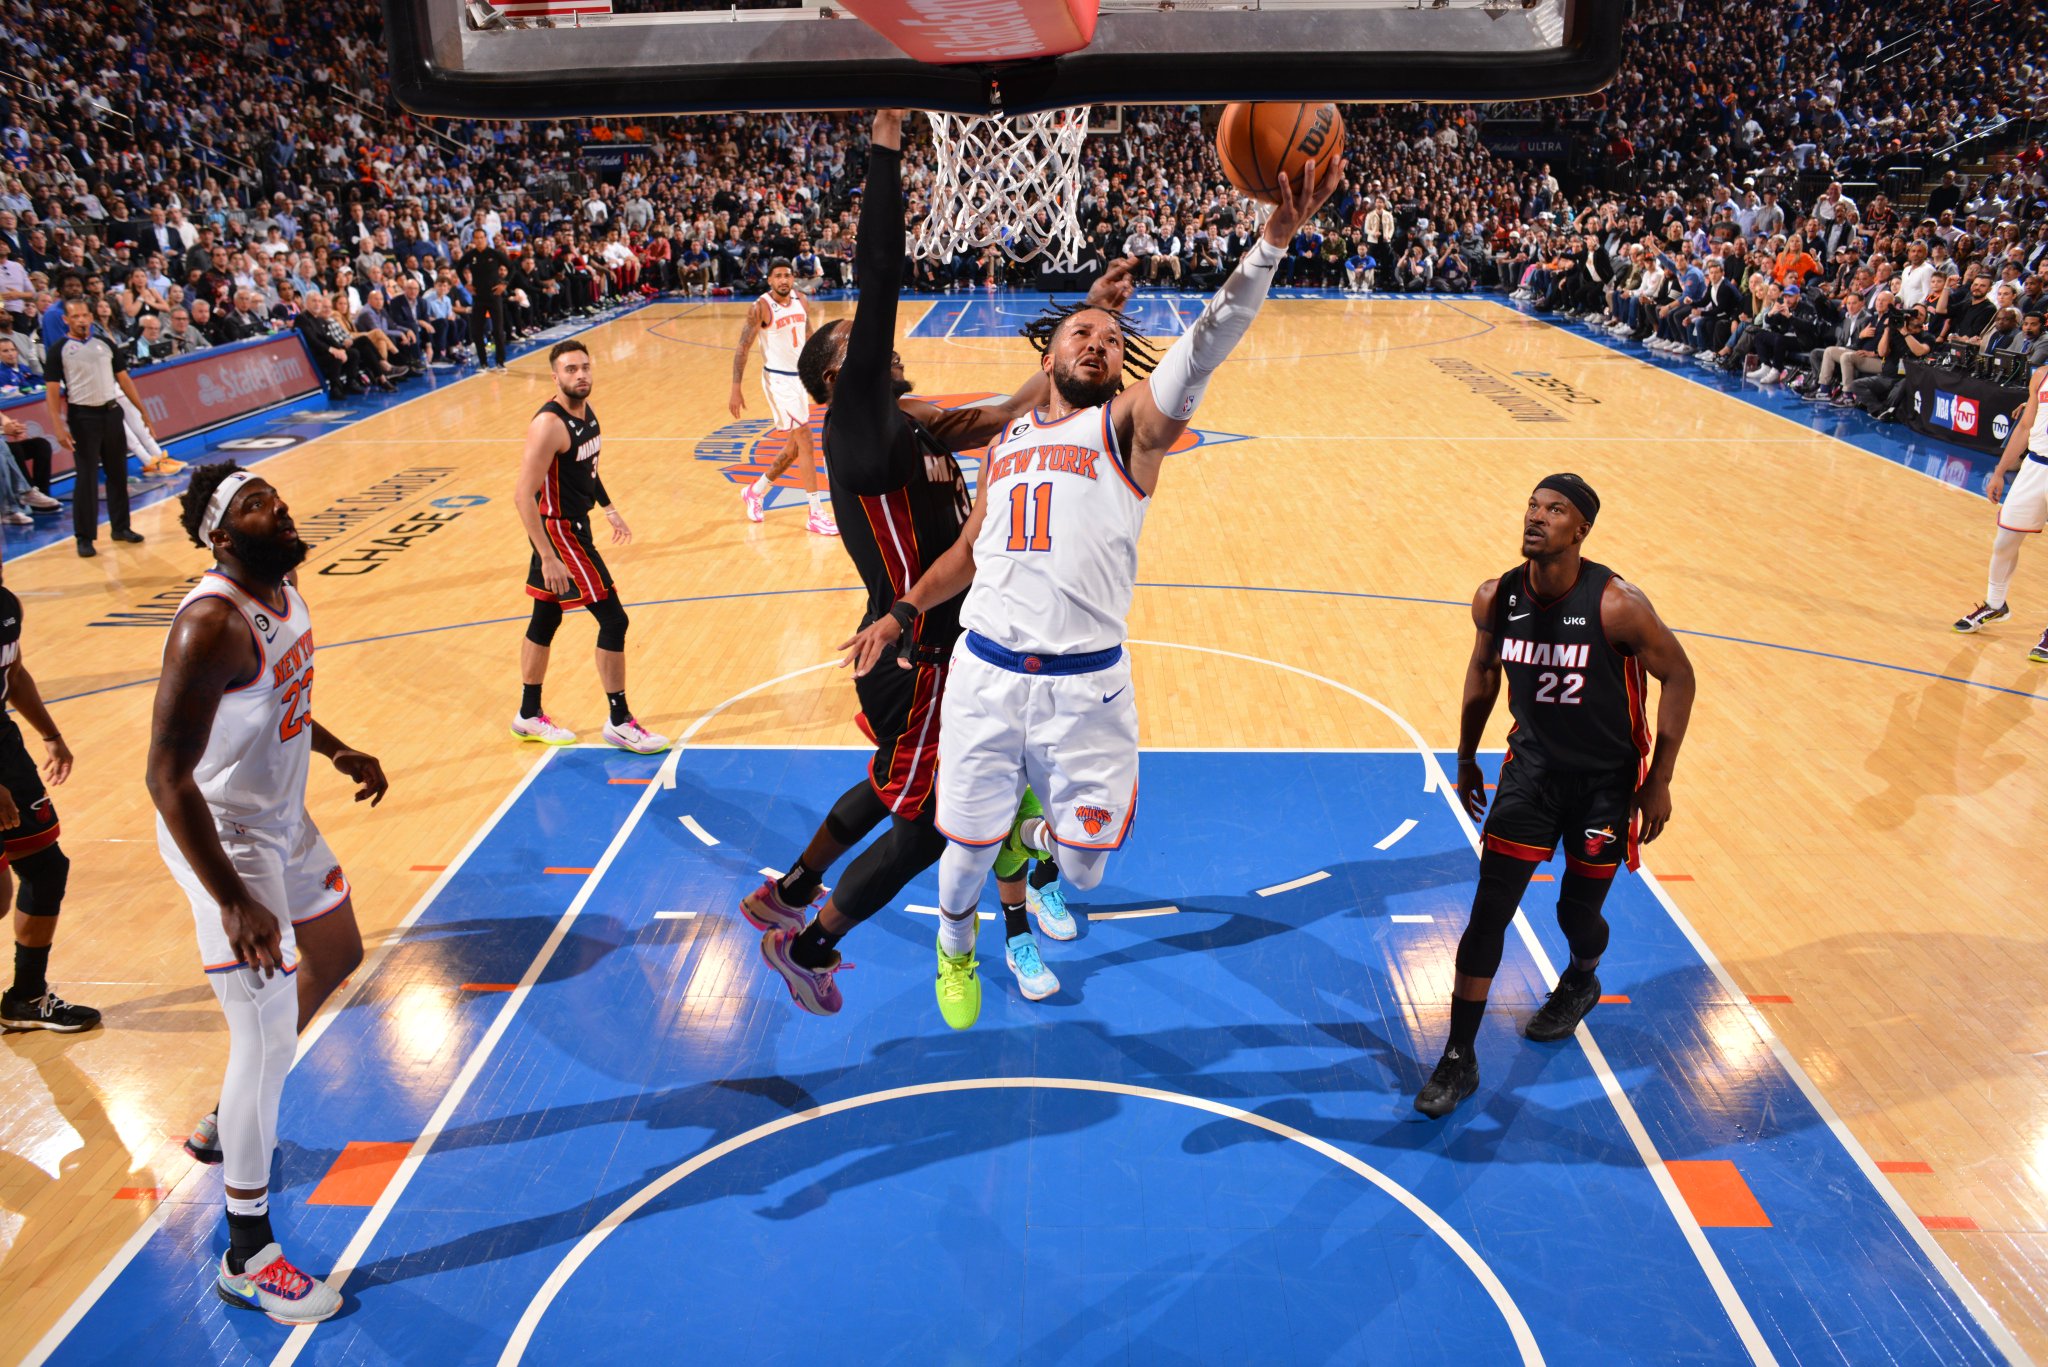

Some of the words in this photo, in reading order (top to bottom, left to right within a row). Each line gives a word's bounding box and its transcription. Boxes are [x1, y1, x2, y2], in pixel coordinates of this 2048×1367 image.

[1528, 142, 1562, 152] ULTRA
[791, 326, 799, 348] 1
[1526, 378, 1602, 404] CHASE
[1935, 397, 1950, 421] NBA
[575, 434, 601, 462] MIAM
[989, 449, 1037, 488] NEW
[1036, 443, 1101, 482] YORK
[336, 467, 459, 504] GARDEN
[1006, 481, 1053, 552] 11
[318, 511, 465, 577] CHASE
[1509, 594, 1517, 607] 6
[256, 615, 268, 630] 6
[1563, 616, 1587, 626] UKG
[273, 640, 303, 690] NEW
[1500, 637, 1591, 668] MIAMI
[1535, 671, 1585, 705] 22
[279, 665, 314, 743] 23
[1075, 805, 1113, 825] KNICKS
